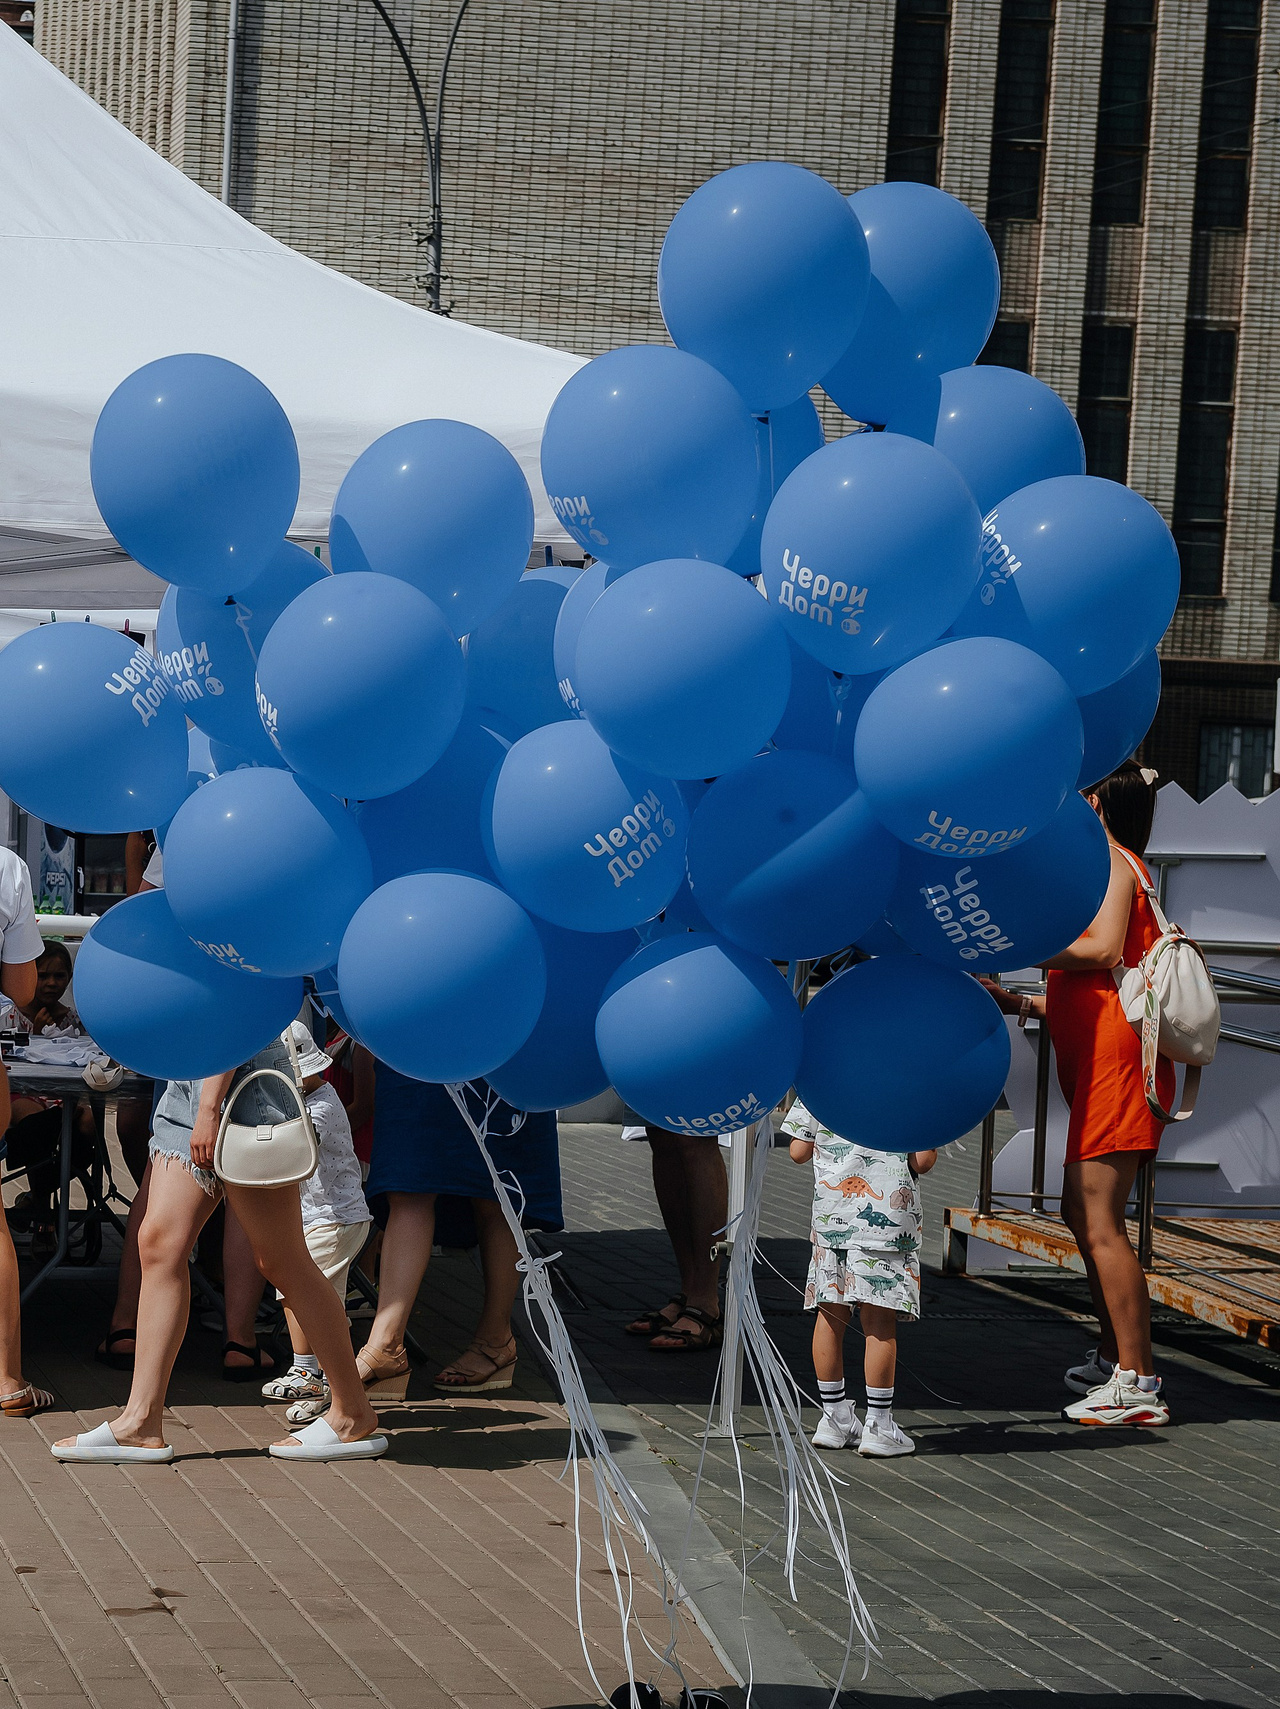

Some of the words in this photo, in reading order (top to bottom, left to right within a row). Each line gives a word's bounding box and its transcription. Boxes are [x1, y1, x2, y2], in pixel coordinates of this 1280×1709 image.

[783, 548, 868, 608] Черри
[778, 580, 833, 626] Дом
[131, 675, 169, 728] Дом
[175, 678, 204, 704] ом
[583, 789, 661, 857] Черри
[914, 832, 986, 855] Дом
[928, 810, 1028, 848] Черри
[46, 871, 67, 887] PEPSI
[607, 832, 663, 888] Дом
[919, 884, 968, 944] Дом
[952, 865, 1015, 952] Черри
[664, 1092, 758, 1129] Черри
